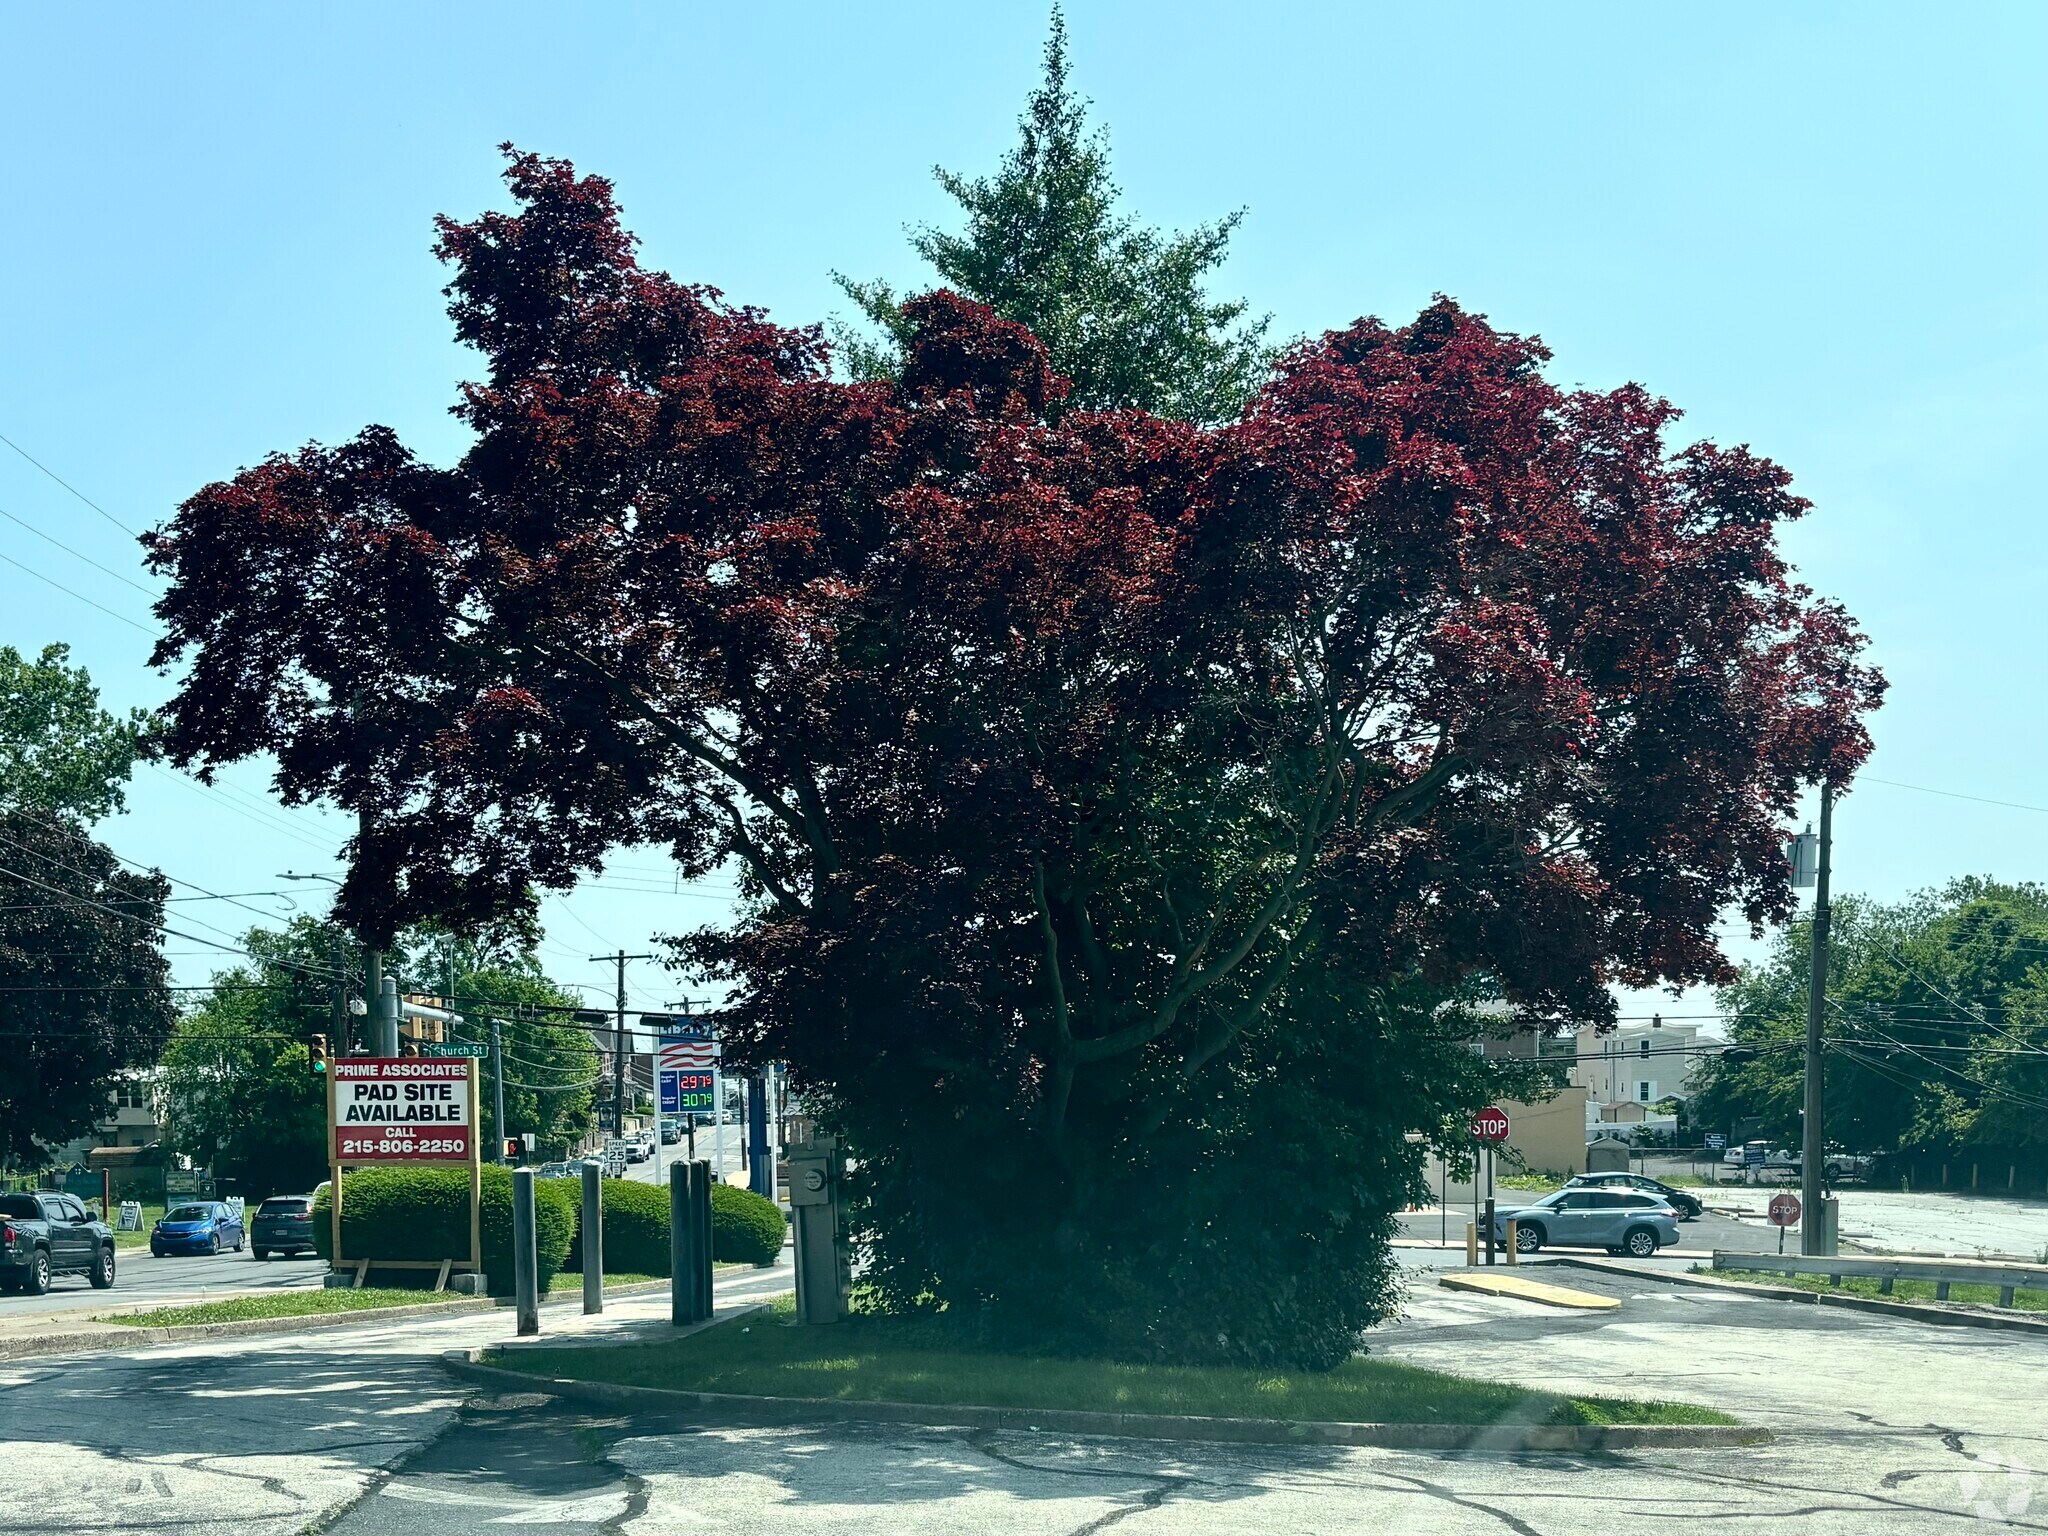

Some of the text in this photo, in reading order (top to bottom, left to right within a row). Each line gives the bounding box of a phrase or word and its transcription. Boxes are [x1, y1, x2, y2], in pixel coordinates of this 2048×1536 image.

[472, 1045, 483, 1055] St
[335, 1064, 467, 1077] PRIME ASSOCIATES
[354, 1083, 452, 1101] PAD SITE
[346, 1104, 461, 1122] AVAILABLE
[385, 1127, 417, 1138] CALL
[1472, 1120, 1507, 1135] STOP
[343, 1139, 464, 1154] 215-806-2250
[609, 1151, 625, 1160] 25
[1772, 1205, 1798, 1215] STOP
